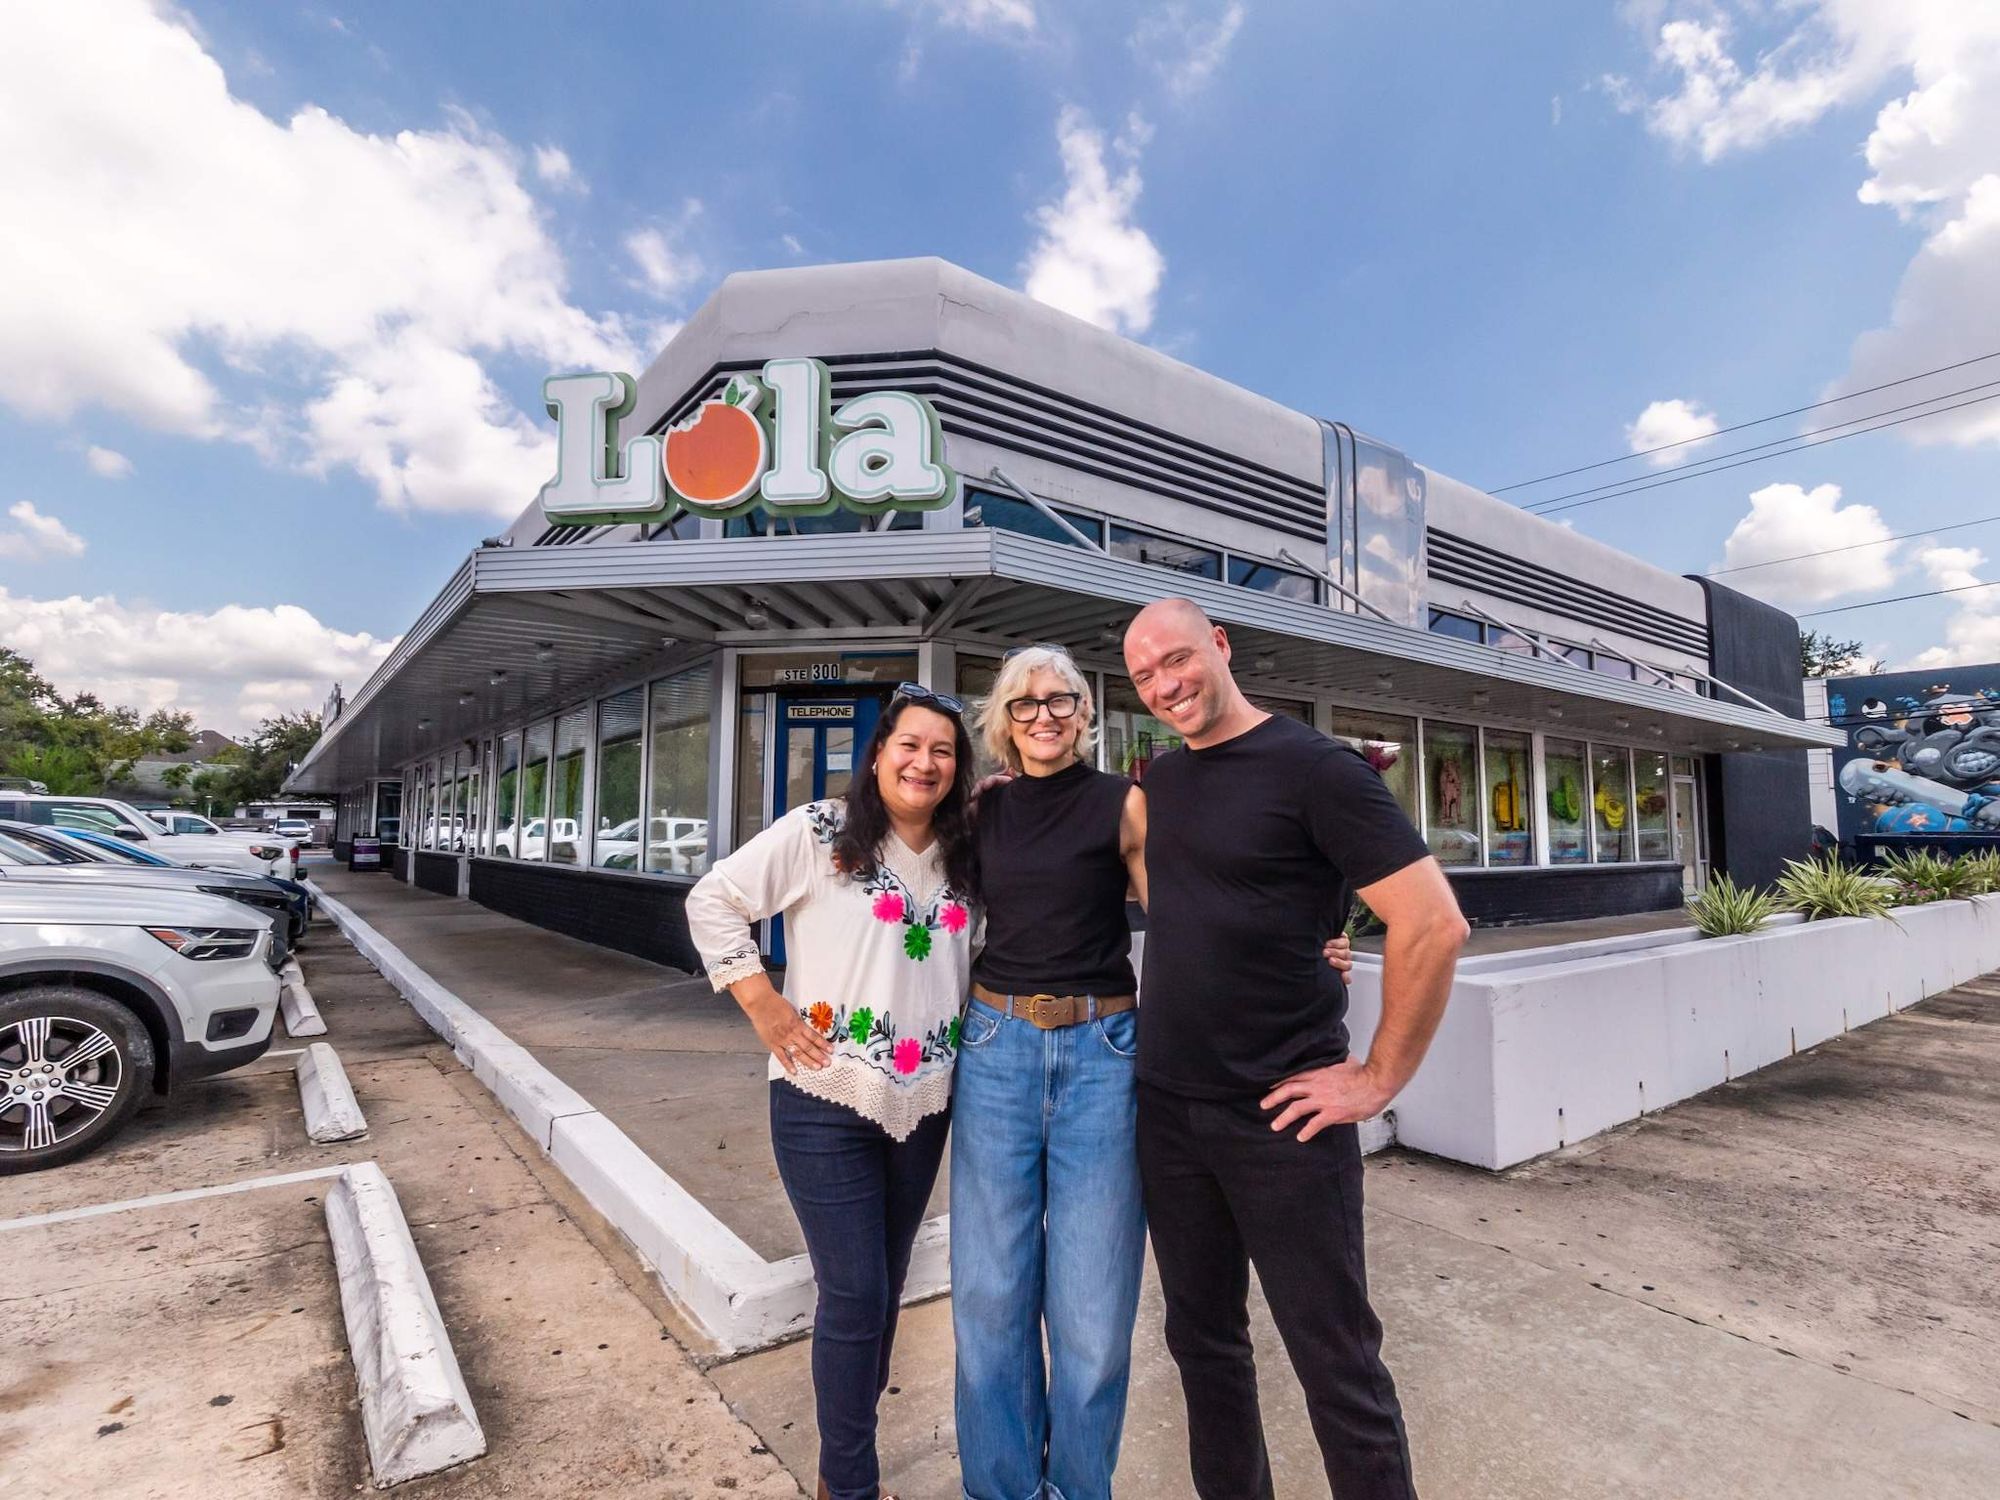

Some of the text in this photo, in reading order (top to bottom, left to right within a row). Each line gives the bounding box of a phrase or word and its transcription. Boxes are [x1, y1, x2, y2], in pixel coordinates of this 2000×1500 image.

[541, 358, 952, 519] Lola
[785, 664, 839, 680] STE 300
[790, 707, 852, 717] TELEPHONE
